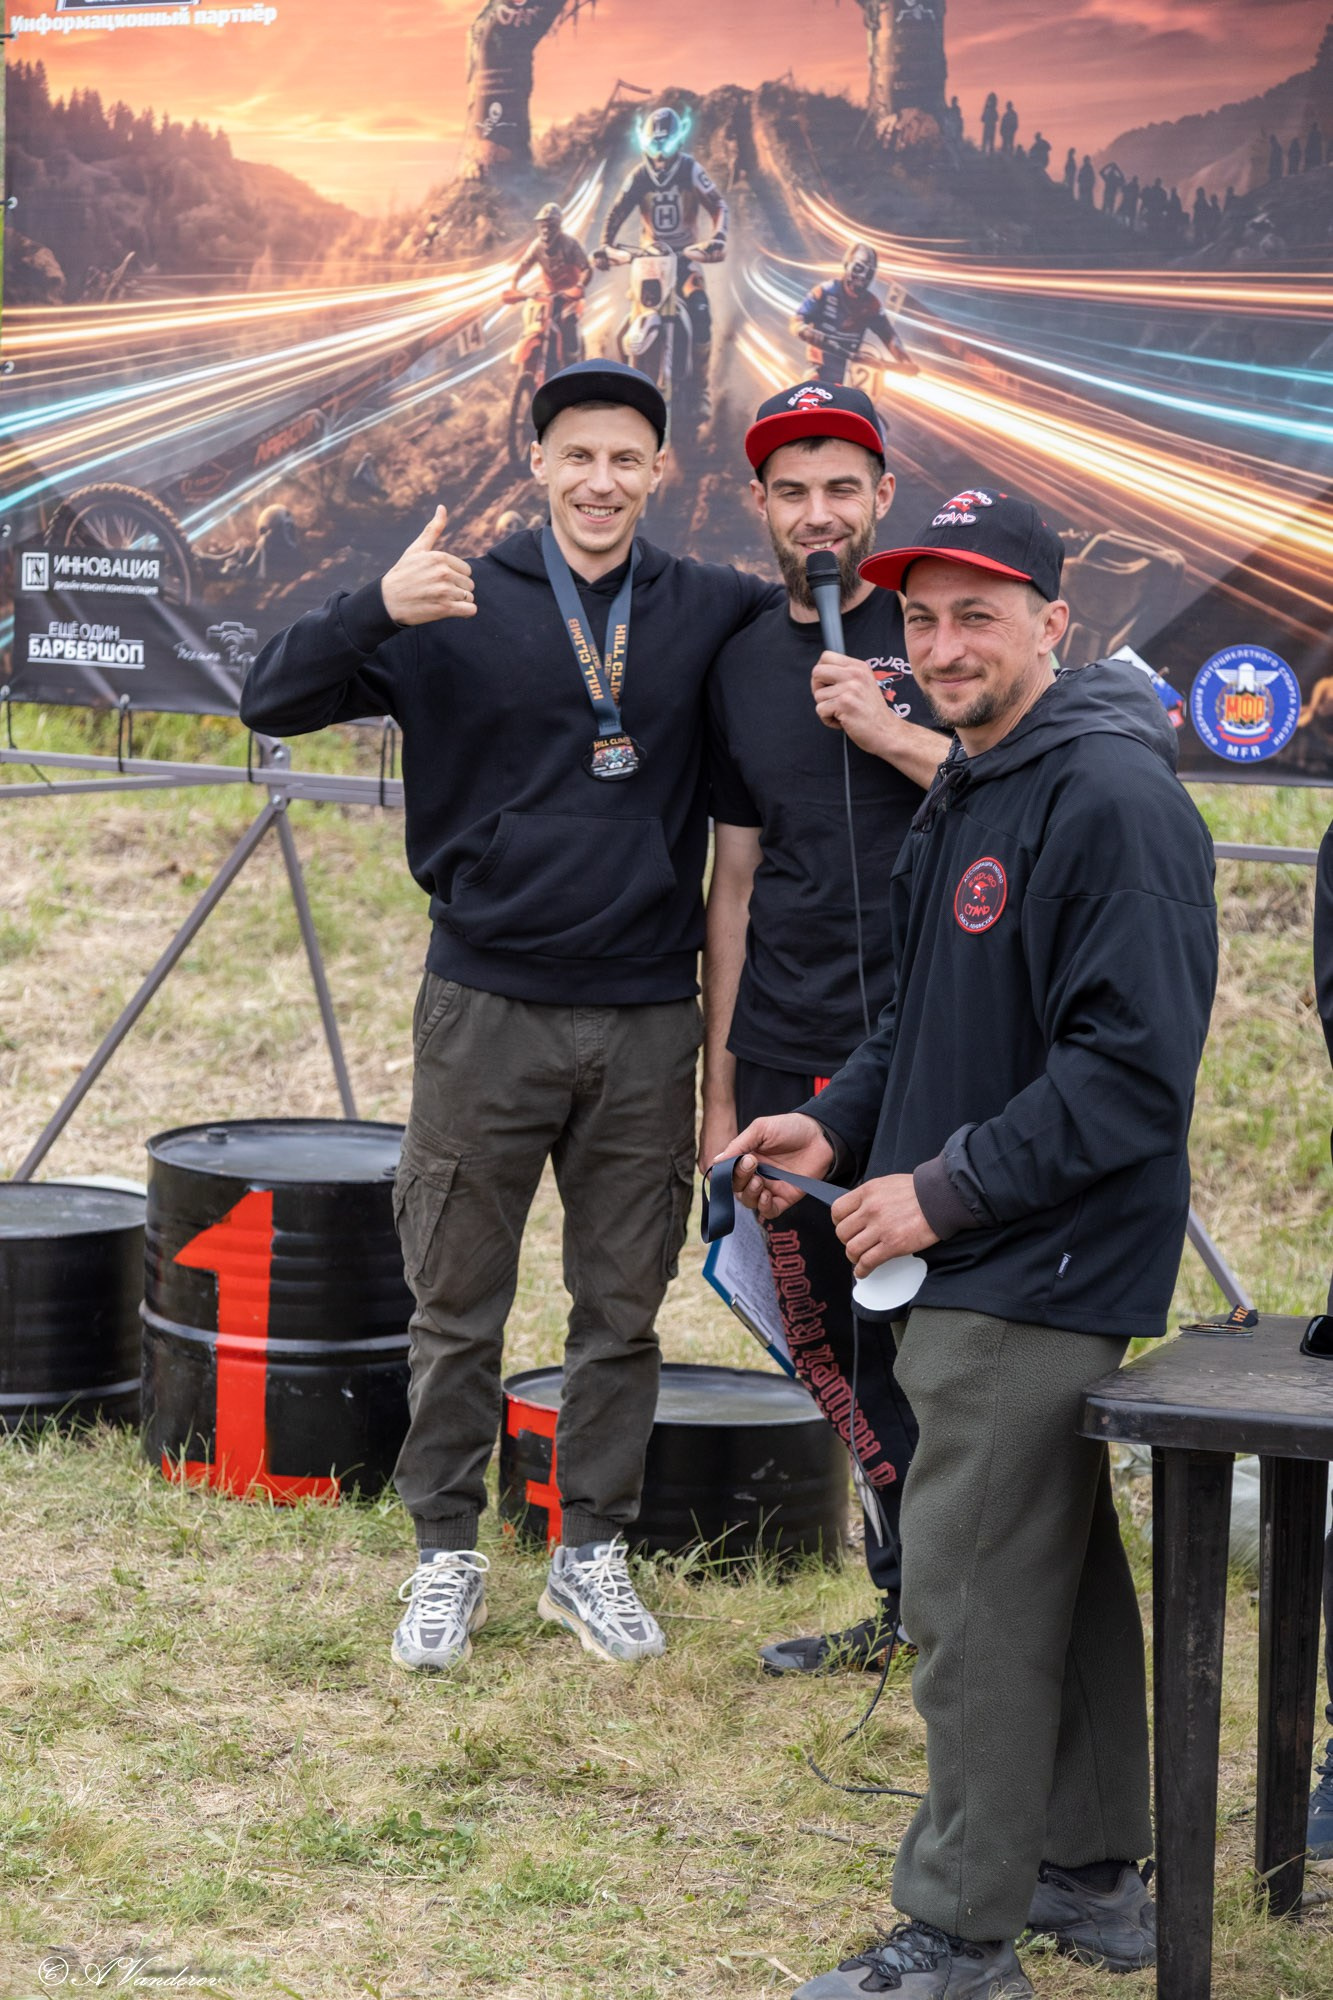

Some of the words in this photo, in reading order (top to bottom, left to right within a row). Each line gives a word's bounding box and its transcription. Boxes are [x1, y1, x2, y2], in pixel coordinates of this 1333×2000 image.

[10, 7, 190, 35] Информационный
[193, 3, 278, 27] партнёр
[53, 554, 160, 580] ИННОВАЦИЯ
[49, 620, 79, 638] ЕЩЁ
[79, 623, 120, 641] ОДИН
[567, 617, 591, 664] CLIMB
[612, 624, 627, 659] HILL
[28, 640, 144, 663] БАРБЕРШОП
[865, 656, 913, 674] DURO
[584, 665, 604, 700] HILL
[1279, 666, 1297, 705] СПОРТА
[1224, 693, 1266, 723] МФР
[1272, 707, 1297, 746] РОССИИ
[1226, 744, 1261, 758] MFR
[162, 1190, 340, 1508] 1
